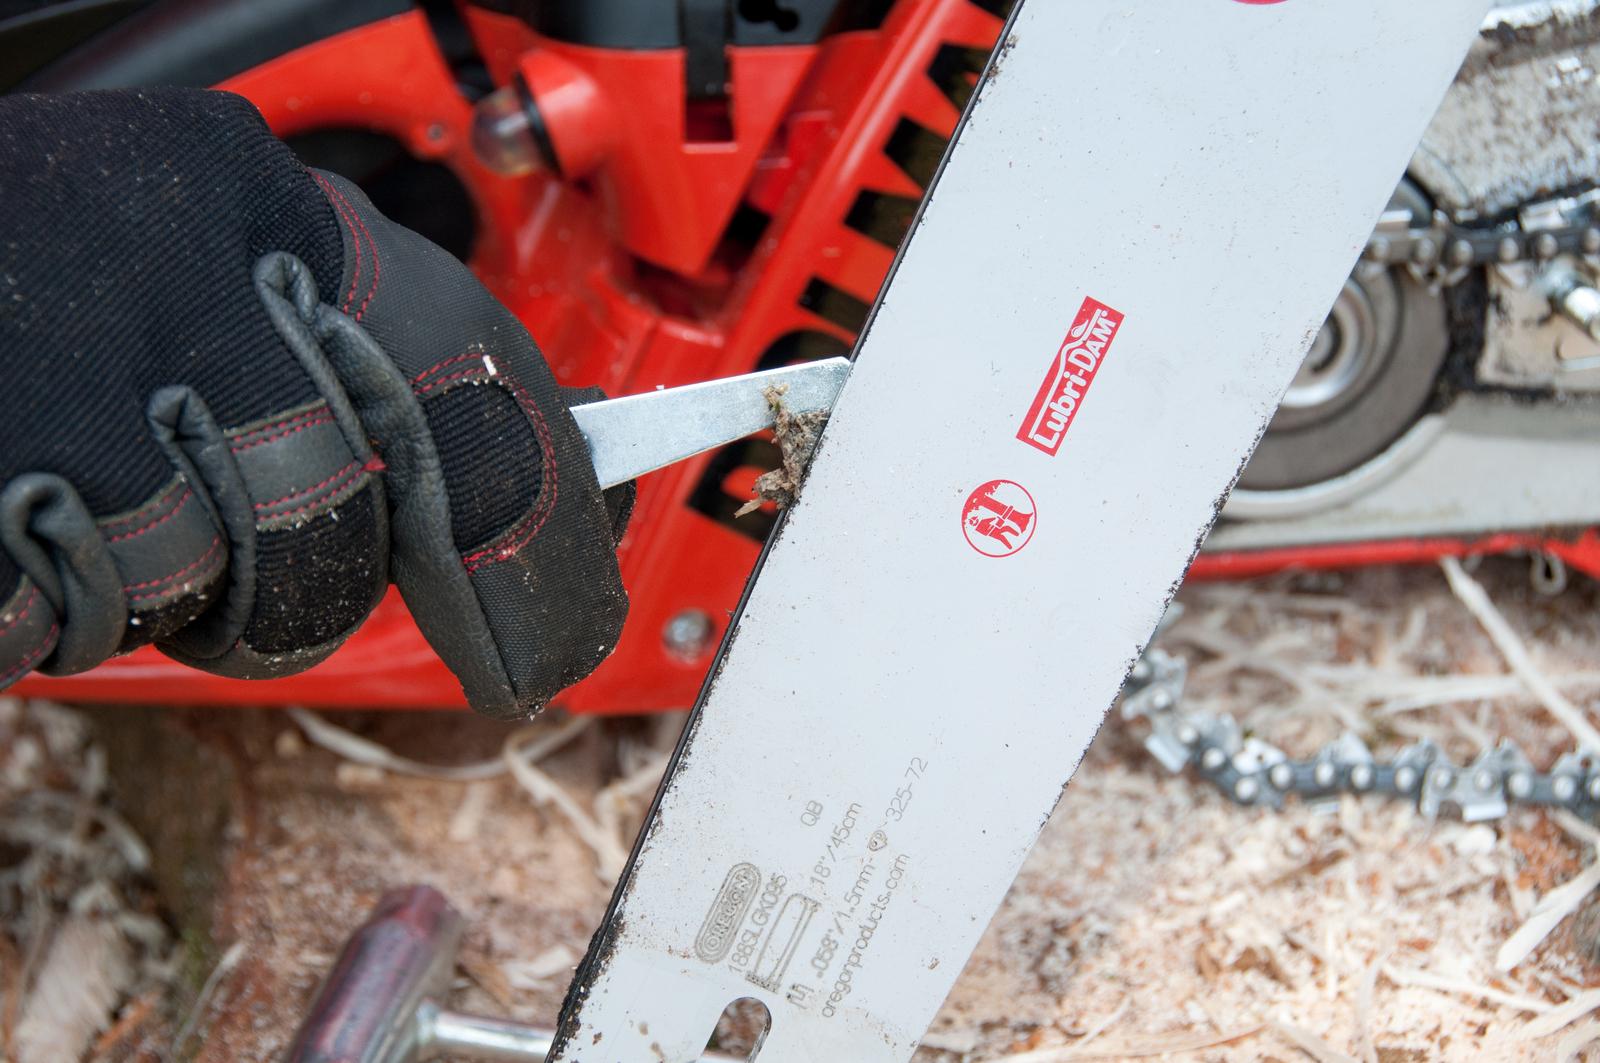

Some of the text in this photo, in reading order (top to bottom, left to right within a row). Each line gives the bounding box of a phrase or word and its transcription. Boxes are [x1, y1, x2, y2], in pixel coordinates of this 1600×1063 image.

[1033, 316, 1117, 449] Lubri-DAM
[800, 800, 823, 827] QB
[705, 871, 751, 948] OREGON
[821, 853, 910, 1018] oregonproducts.com
